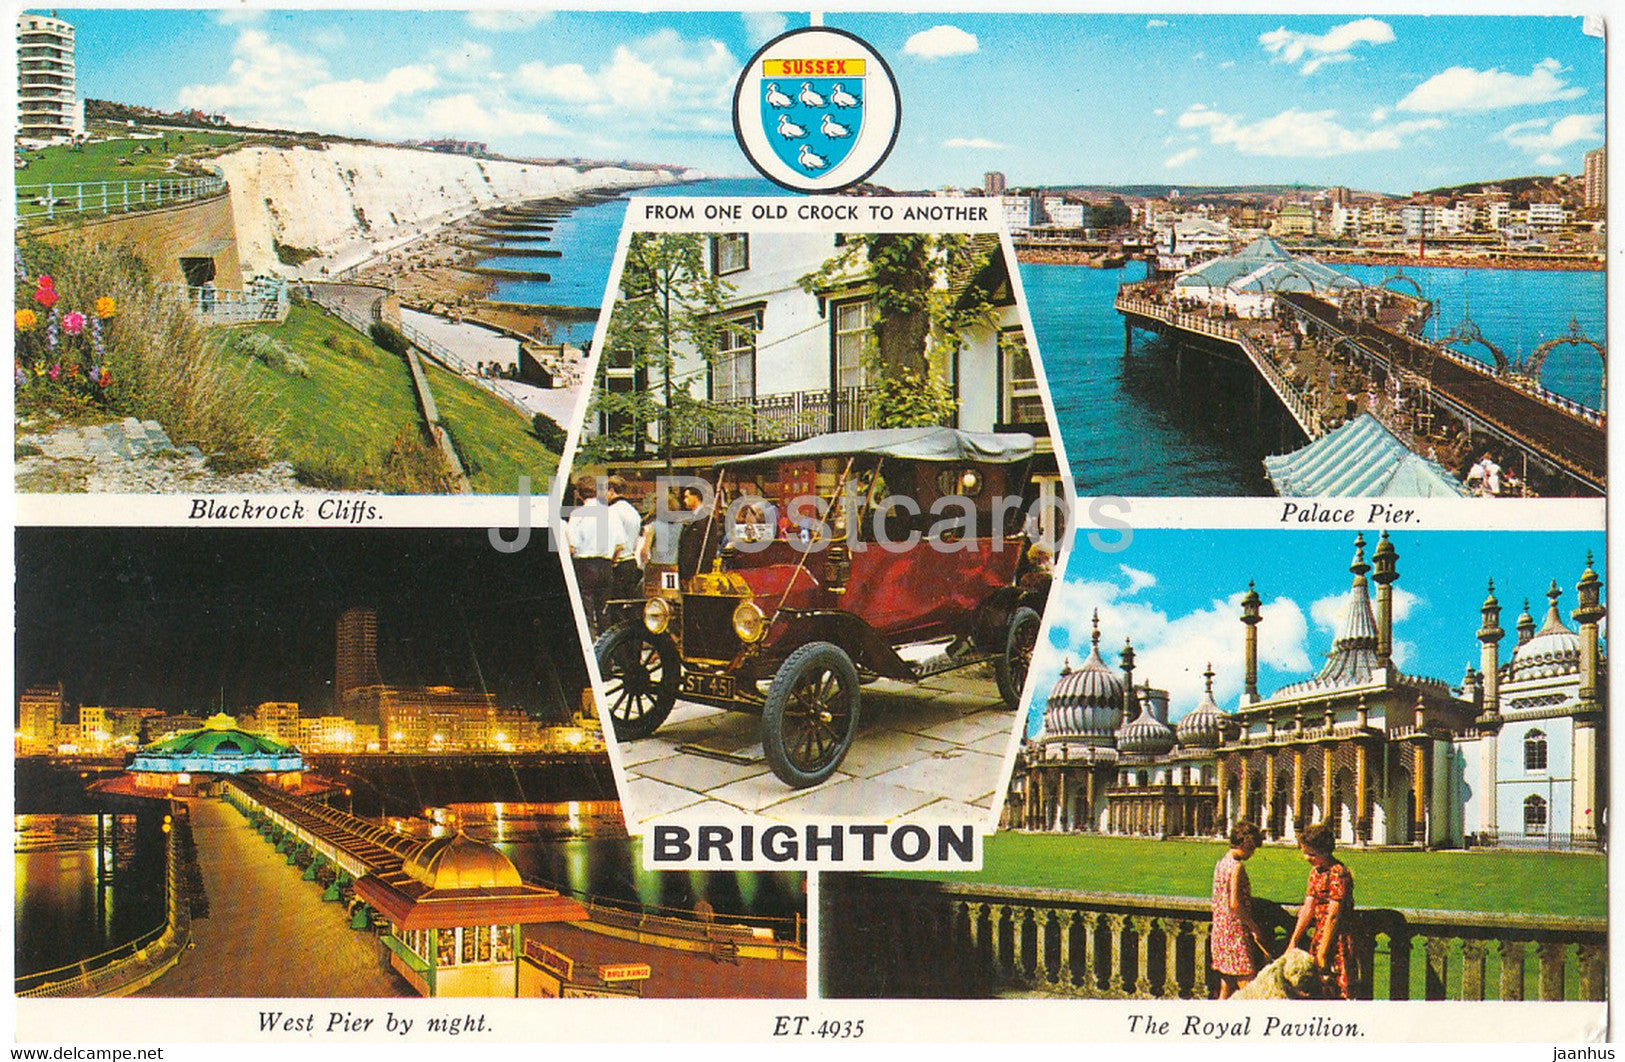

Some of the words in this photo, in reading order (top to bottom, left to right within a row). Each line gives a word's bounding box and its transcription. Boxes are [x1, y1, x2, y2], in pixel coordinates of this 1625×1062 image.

[782, 60, 846, 75] SUSSEX
[645, 204, 695, 220] FROM
[704, 204, 742, 220] ONE
[751, 204, 788, 220] OLD
[797, 205, 858, 220] CROCK
[868, 205, 894, 220] TO
[903, 206, 988, 221] ANOTHER
[189, 499, 304, 520] Blackrock
[318, 499, 384, 524] Cliffs.
[1280, 502, 1355, 523] Palace
[1367, 503, 1421, 525] Pier.
[686, 675, 704, 692] ST
[653, 825, 974, 863] BRIGHTON
[259, 1012, 314, 1032] West
[327, 1012, 374, 1032] Pier
[386, 1012, 414, 1036] by
[428, 1012, 493, 1036] night.
[773, 1016, 864, 1039] ET.4935
[1128, 1015, 1169, 1035] The
[1181, 1015, 1251, 1039] Royal
[1263, 1016, 1367, 1037] Pavilion.
